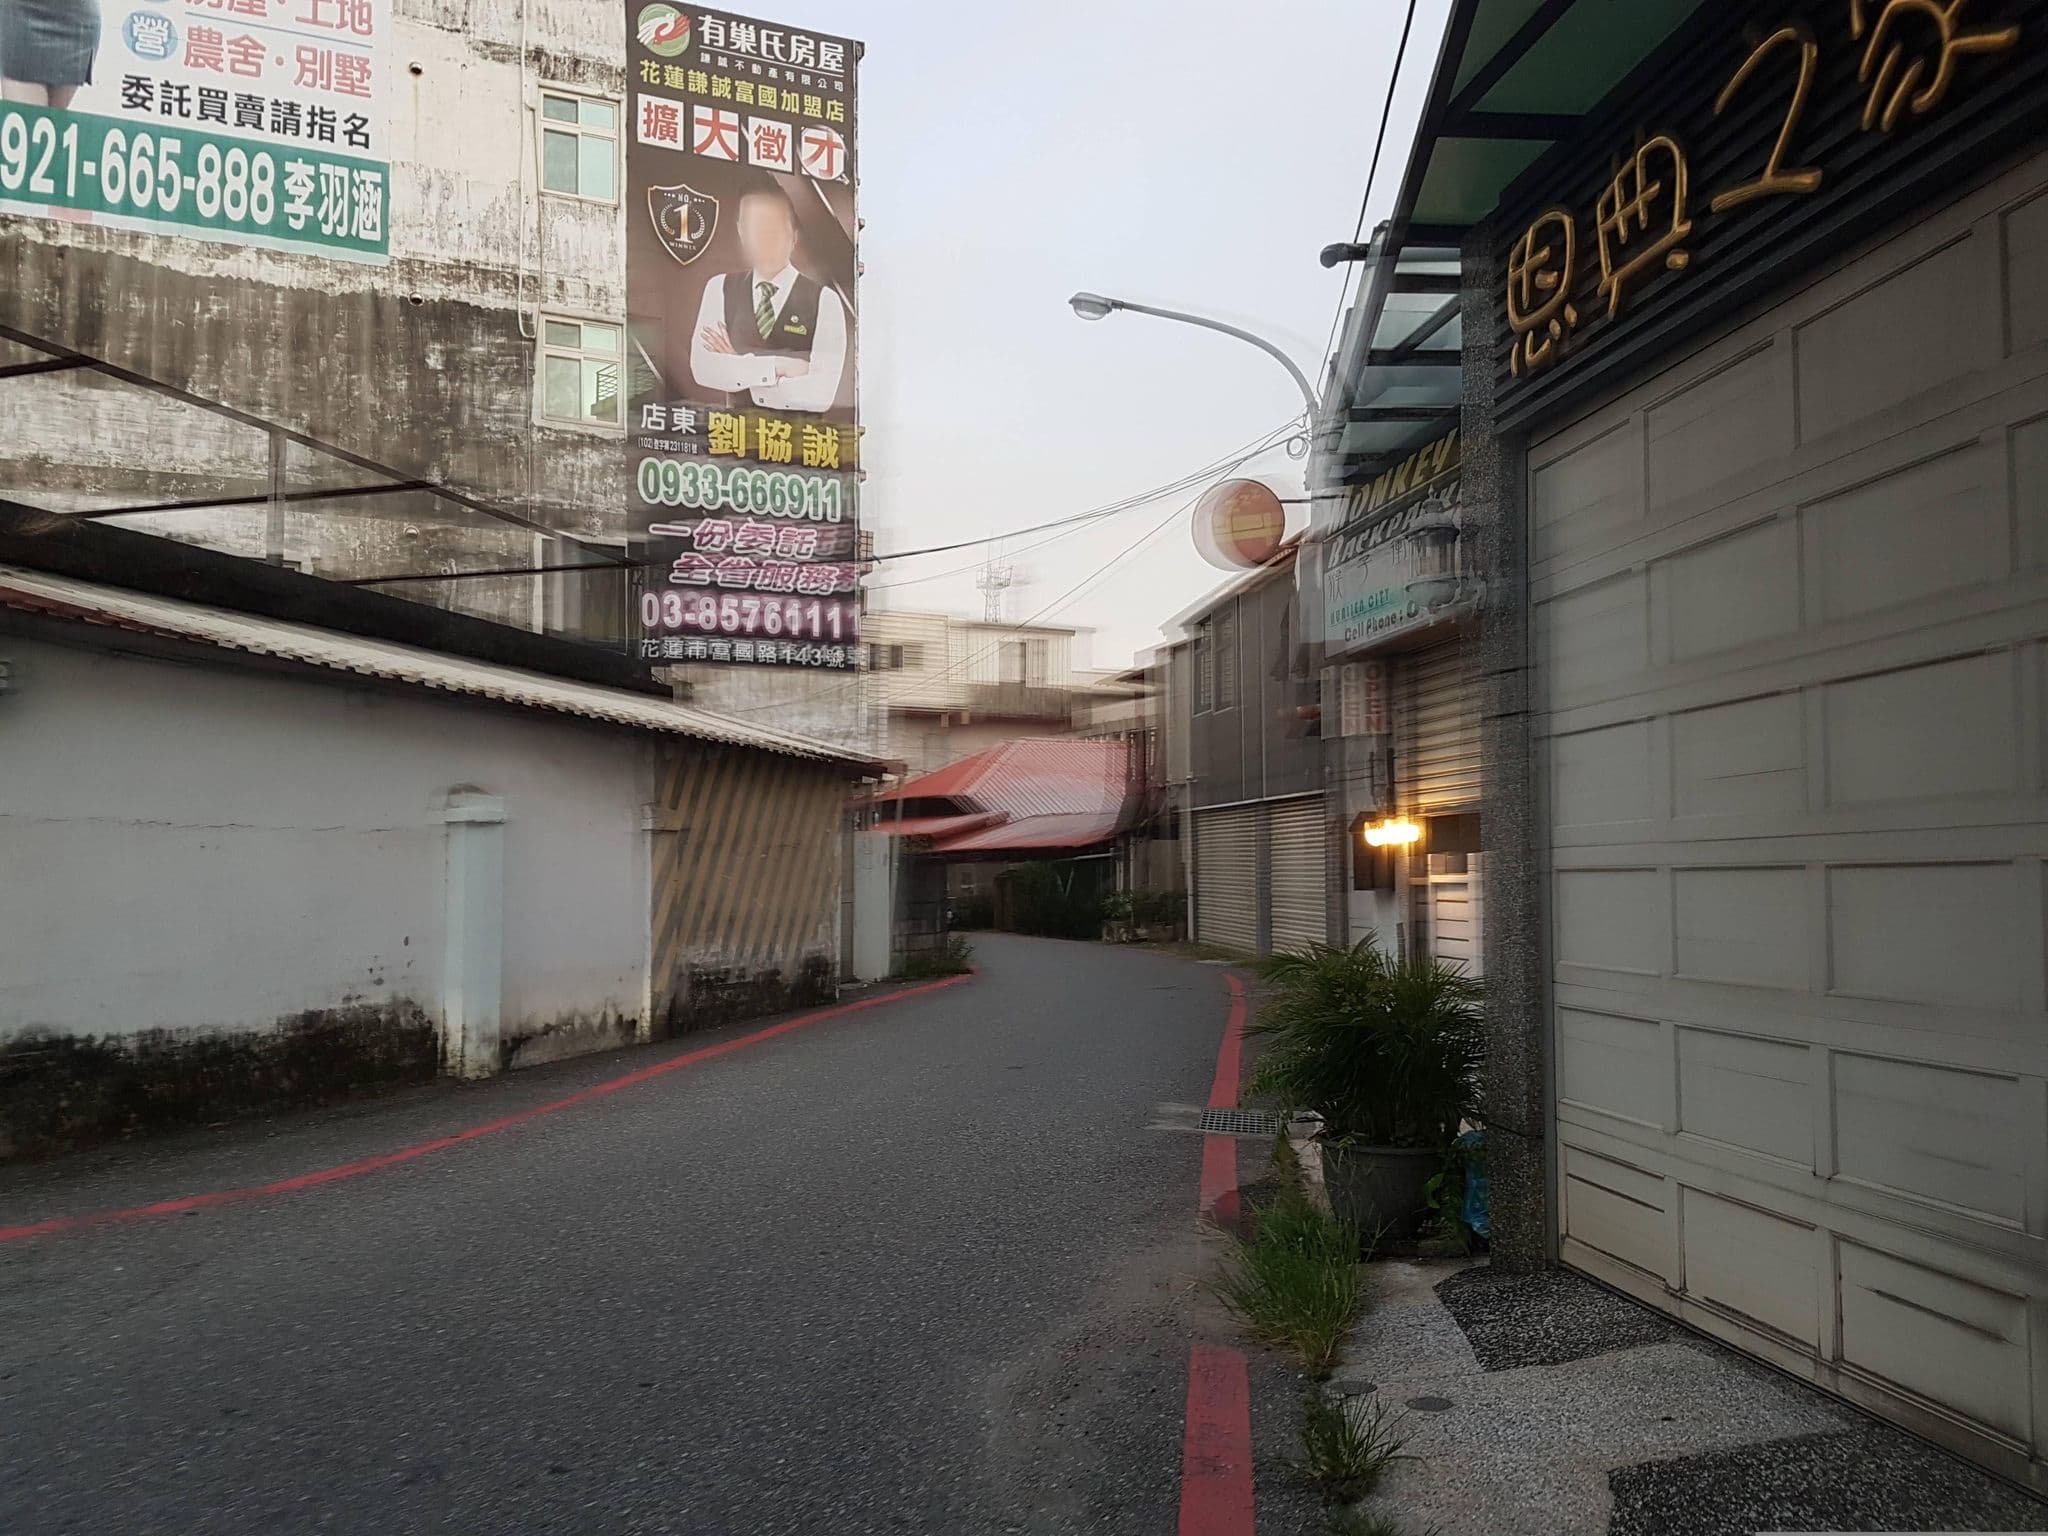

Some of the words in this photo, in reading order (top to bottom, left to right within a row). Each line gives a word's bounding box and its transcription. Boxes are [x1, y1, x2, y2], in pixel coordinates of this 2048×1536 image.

[132, 15, 170, 56] 營
[698, 14, 845, 73] 有巢氏房屋
[121, 74, 371, 149] 委託買賣請指名
[639, 59, 845, 123] 花蓮謙誠富國加盟店
[643, 100, 844, 178] 擴大徵才
[1, 111, 275, 226] 921-665-888
[283, 158, 383, 242] 李羽涵
[641, 402, 697, 434] 店東
[707, 411, 840, 469] 劉協誠
[638, 457, 841, 523] 0933-666911
[649, 519, 817, 559] 一份委託
